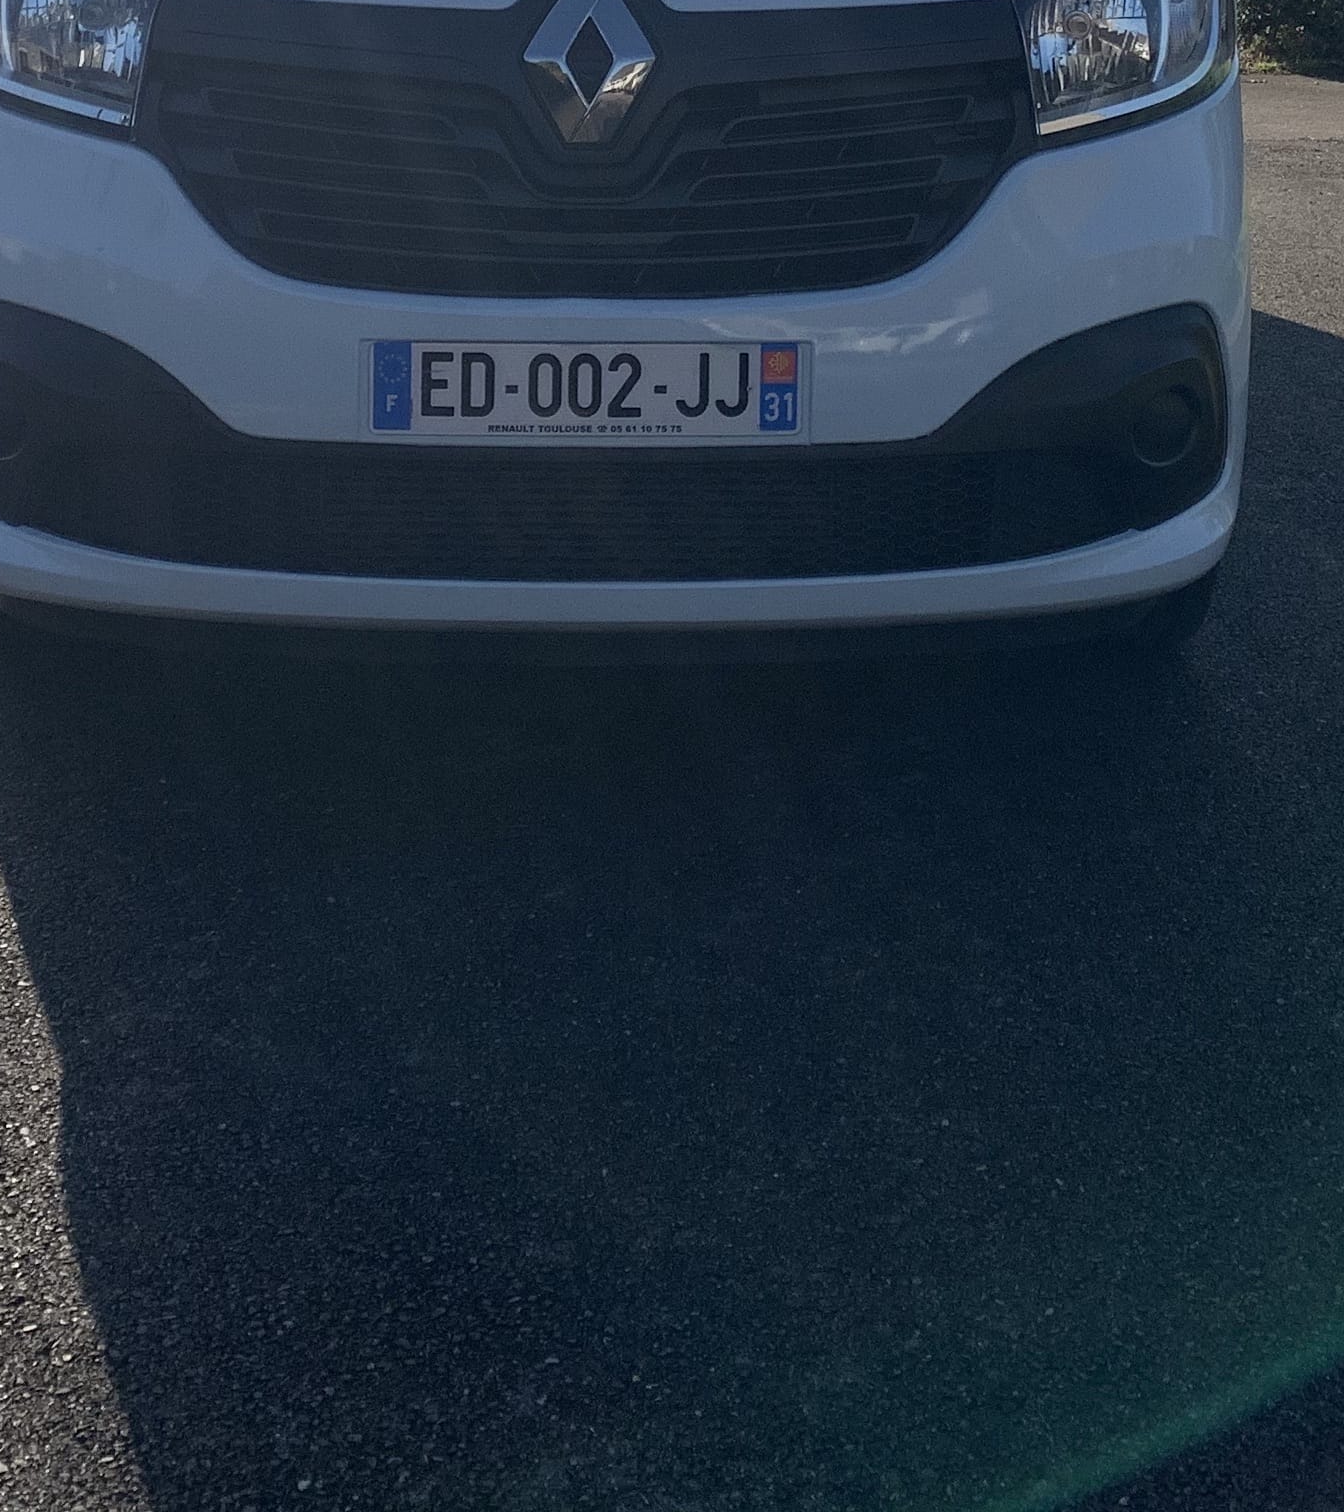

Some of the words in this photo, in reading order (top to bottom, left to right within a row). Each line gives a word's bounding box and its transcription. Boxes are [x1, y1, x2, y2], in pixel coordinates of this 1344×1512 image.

[420, 351, 750, 419] ED-002-JJ
[385, 394, 398, 413] F
[764, 392, 793, 423] 31
[487, 424, 534, 433] RENAULT
[539, 424, 593, 433] TOULOUSE
[610, 424, 623, 433] 05
[626, 424, 637, 433] 61
[641, 424, 652, 433] 10
[656, 424, 668, 433] 75
[670, 424, 683, 433] 75
